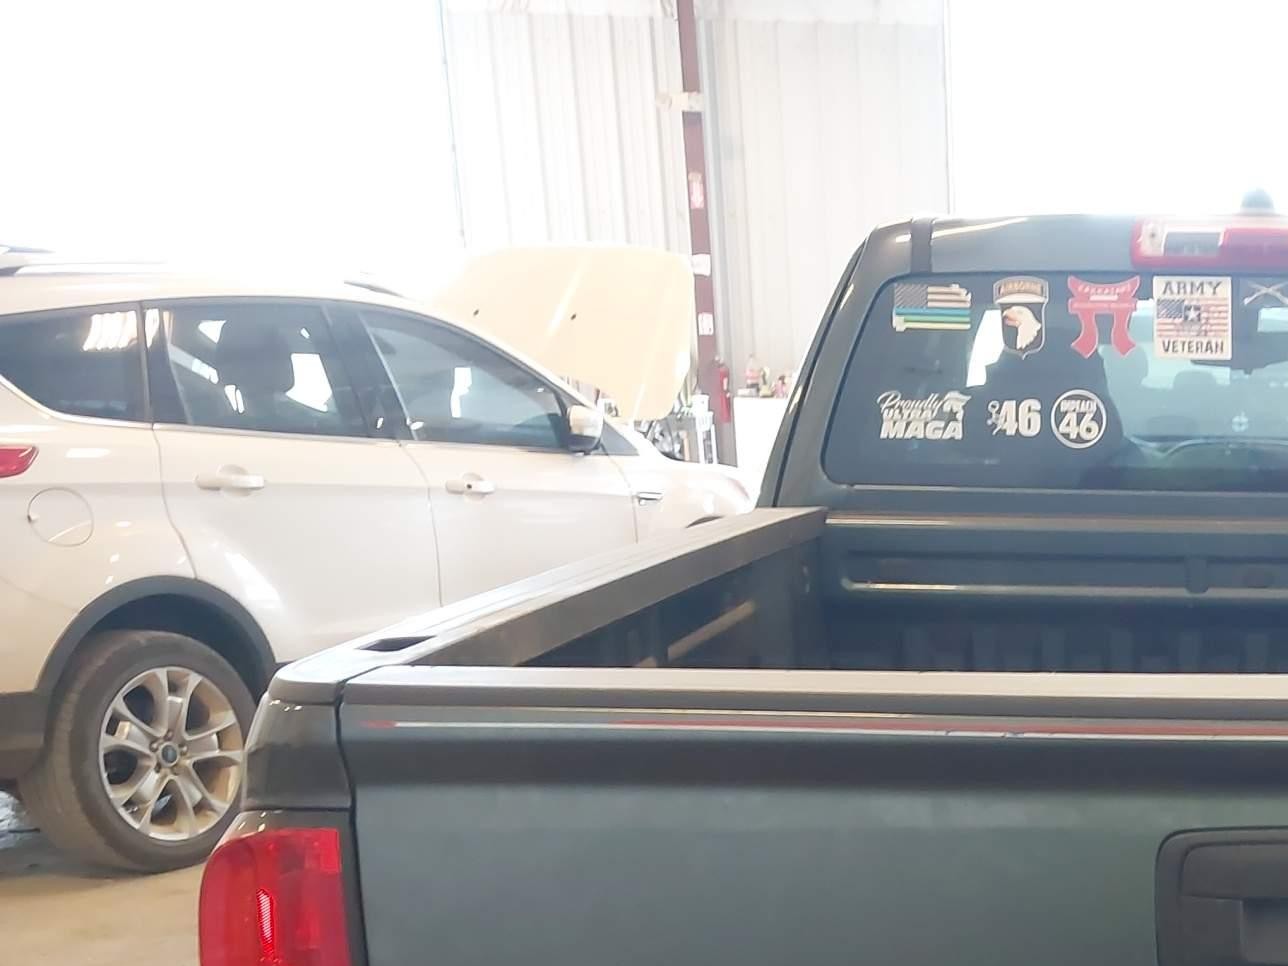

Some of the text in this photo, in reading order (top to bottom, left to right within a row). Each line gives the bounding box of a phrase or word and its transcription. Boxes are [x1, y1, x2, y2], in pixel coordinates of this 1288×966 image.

[1162, 280, 1222, 296] ARMY
[1161, 339, 1225, 356] VETERAN
[877, 390, 944, 418] Proudly
[879, 420, 963, 440] MAGA
[1058, 410, 1100, 441] 46
